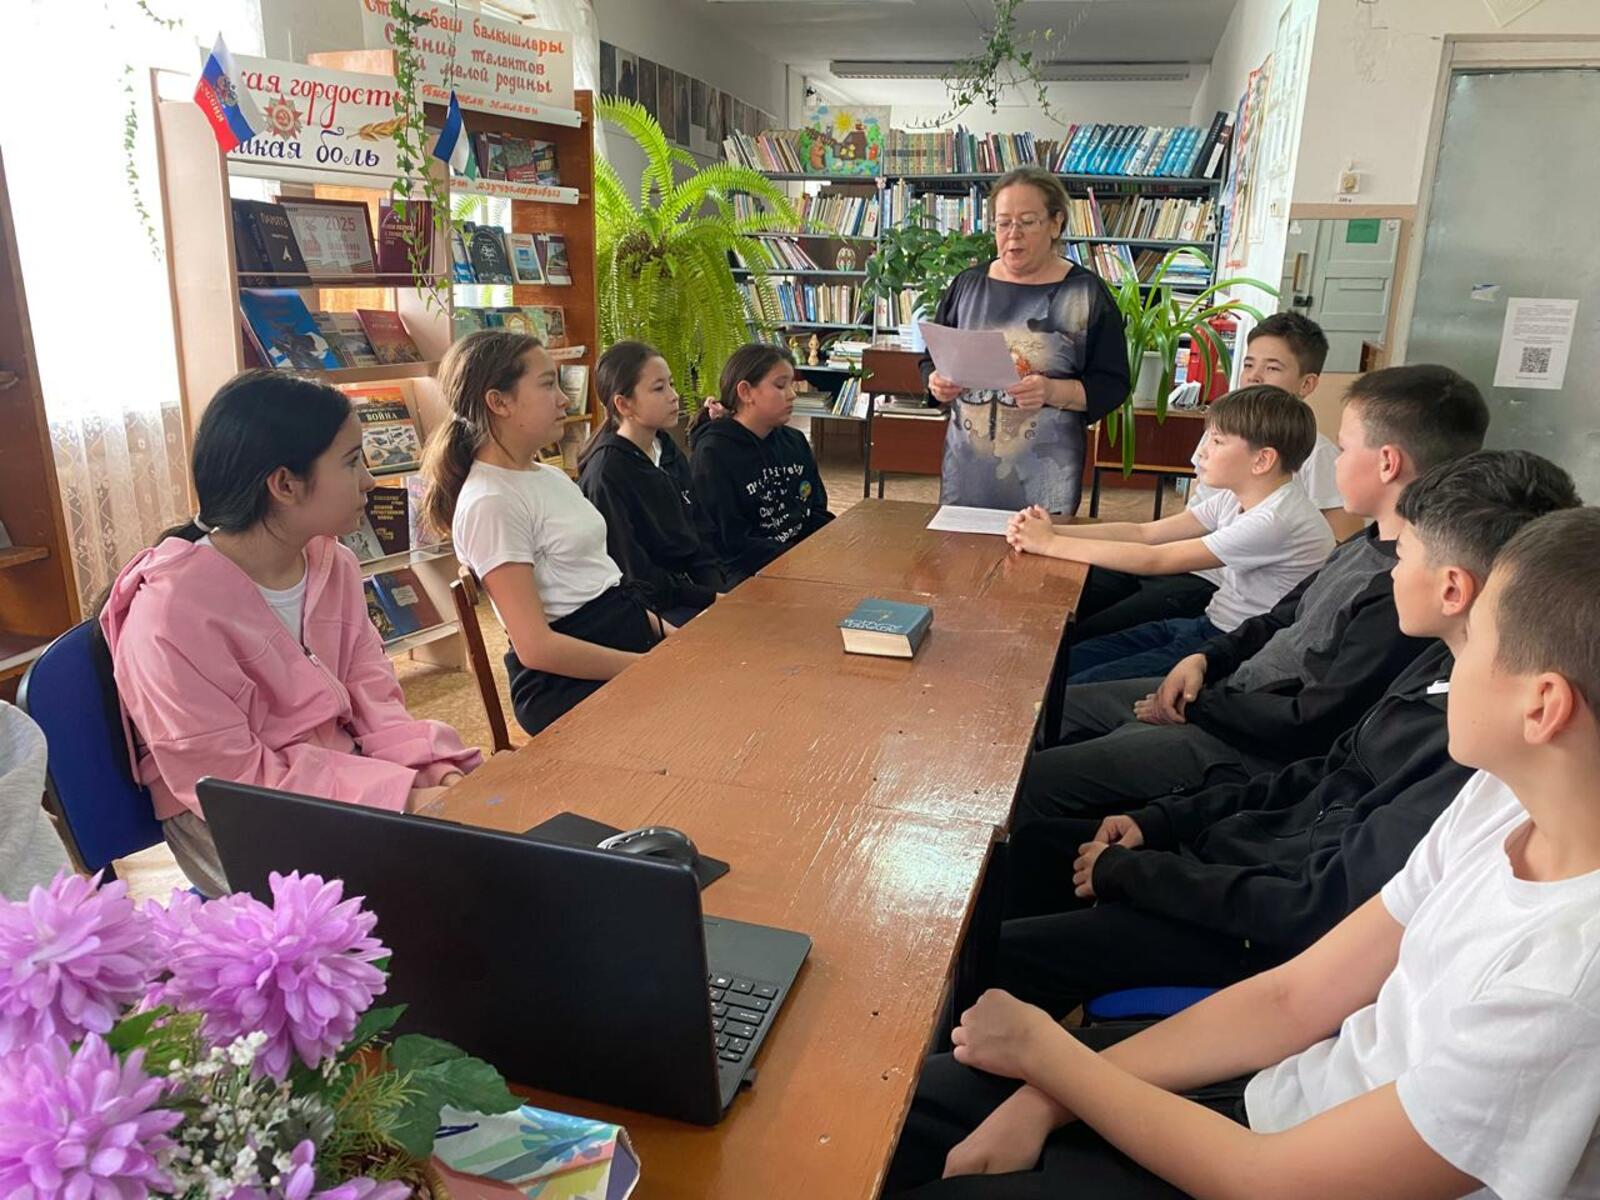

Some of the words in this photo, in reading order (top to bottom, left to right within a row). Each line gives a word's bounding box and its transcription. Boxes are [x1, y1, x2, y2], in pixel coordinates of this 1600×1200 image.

[471, 48, 545, 76] талантов
[495, 71, 553, 95] родины
[316, 126, 380, 167] боль
[325, 215, 356, 232] 2025
